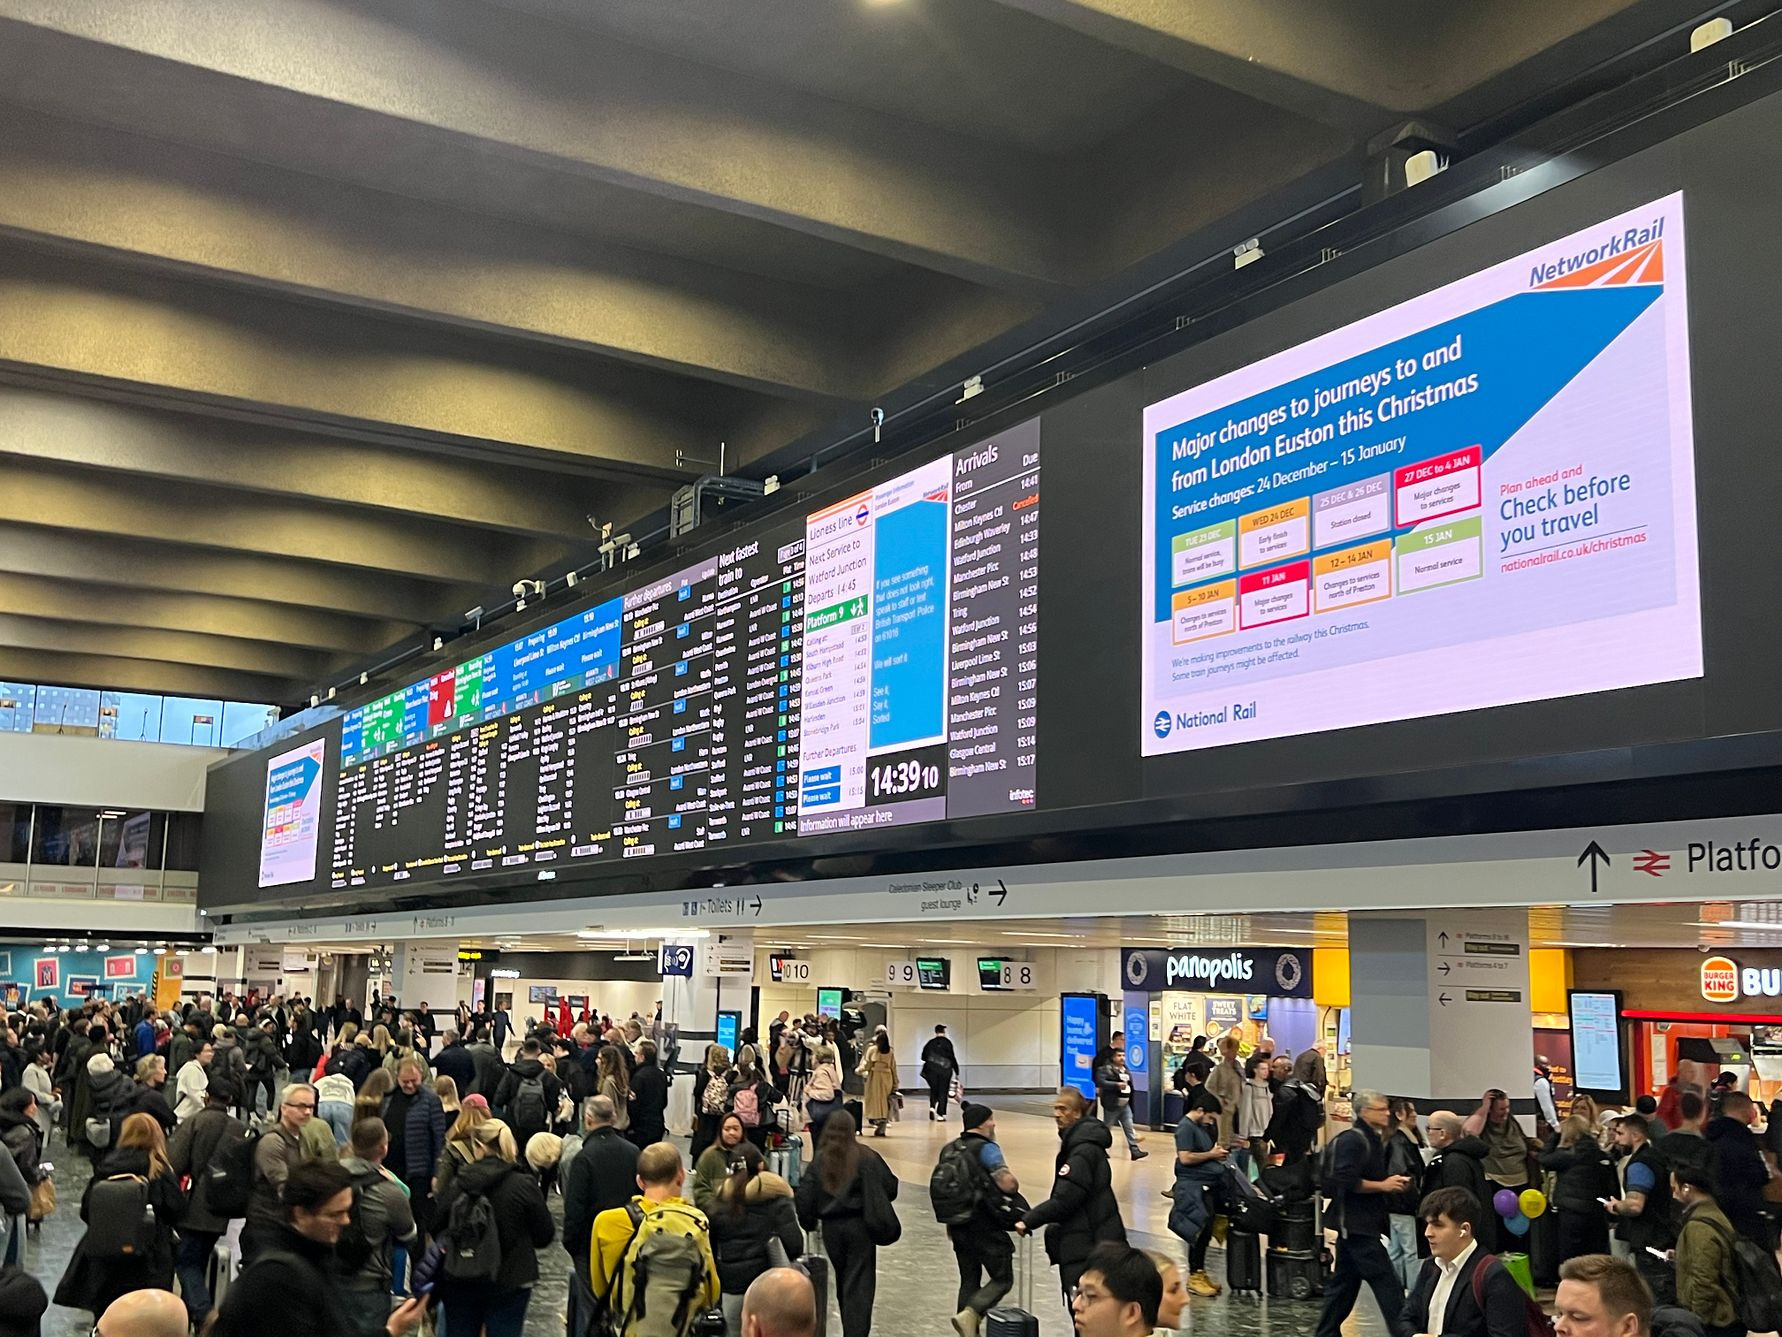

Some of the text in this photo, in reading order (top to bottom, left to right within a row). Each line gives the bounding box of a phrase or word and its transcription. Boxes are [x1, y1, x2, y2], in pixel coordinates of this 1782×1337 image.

[1529, 216, 1665, 288] NetworkRail
[1172, 334, 1462, 461] Major changes to journeys to and
[1171, 373, 1479, 492] from London Euston this Christmas
[955, 444, 998, 477] Arrivals
[1022, 452, 1038, 467] Due
[1404, 454, 1471, 483] 27 DEC to 4 JAN
[955, 479, 973, 494] From
[1172, 500, 1208, 520] Service
[1208, 484, 1255, 508] changes:
[1256, 475, 1271, 494] 24
[1272, 460, 1329, 489] December
[1340, 447, 1356, 466] 15
[1357, 435, 1407, 462] January
[1500, 463, 1583, 497] Plan ahead and
[1319, 480, 1383, 508] 25 DEC & 26 DEC
[1413, 482, 1461, 501] Major changes
[1500, 474, 1631, 521] Check before
[1428, 495, 1454, 509] services
[1252, 506, 1295, 527] WED 24 DEC
[1330, 511, 1372, 530] Station closed
[810, 515, 853, 541] Lioness line
[1423, 529, 1453, 545] 15 JAN
[1500, 502, 1598, 553] you travel
[718, 550, 736, 569] Next
[735, 540, 759, 562] fastest
[809, 540, 861, 567] Next Service to
[1330, 558, 1340, 568] 12
[1347, 553, 1356, 564] 14
[1357, 550, 1373, 562] JAN
[1500, 532, 1647, 573] nationalrail.co.uk/christmas
[808, 557, 867, 585] Watford Junction
[1414, 558, 1463, 574] Normal service
[718, 567, 743, 587] train to
[1262, 572, 1286, 585] 11 JAN
[807, 578, 856, 605] Departs 14:45
[806, 606, 844, 630] Platform 9
[1176, 700, 1257, 730] National Rail
[802, 744, 857, 761] Further Departures
[803, 771, 832, 784] Please wait
[870, 760, 939, 797] 14:39 10
[802, 791, 832, 804] Please wait
[1009, 788, 1034, 801] infotec
[800, 810, 893, 832] Information will appear here
[922, 882, 946, 893] Sleeper
[947, 880, 962, 890] Club
[707, 898, 732, 914] Toilets
[921, 899, 961, 912] guest lounge
[794, 964, 809, 978] 10
[889, 965, 895, 980] 9
[903, 966, 913, 981] 9
[1004, 966, 1011, 983] 8
[1021, 967, 1031, 984] 8
[1167, 952, 1253, 988] panopolis
[1704, 972, 1734, 980] BURGER
[1704, 981, 1735, 991] KING
[1742, 968, 1782, 996] BU
[1173, 1001, 1192, 1010] FLAT
[1212, 1000, 1236, 1009] SWEET
[1212, 1008, 1237, 1016] TREATS
[1169, 1012, 1196, 1021] WHITE
